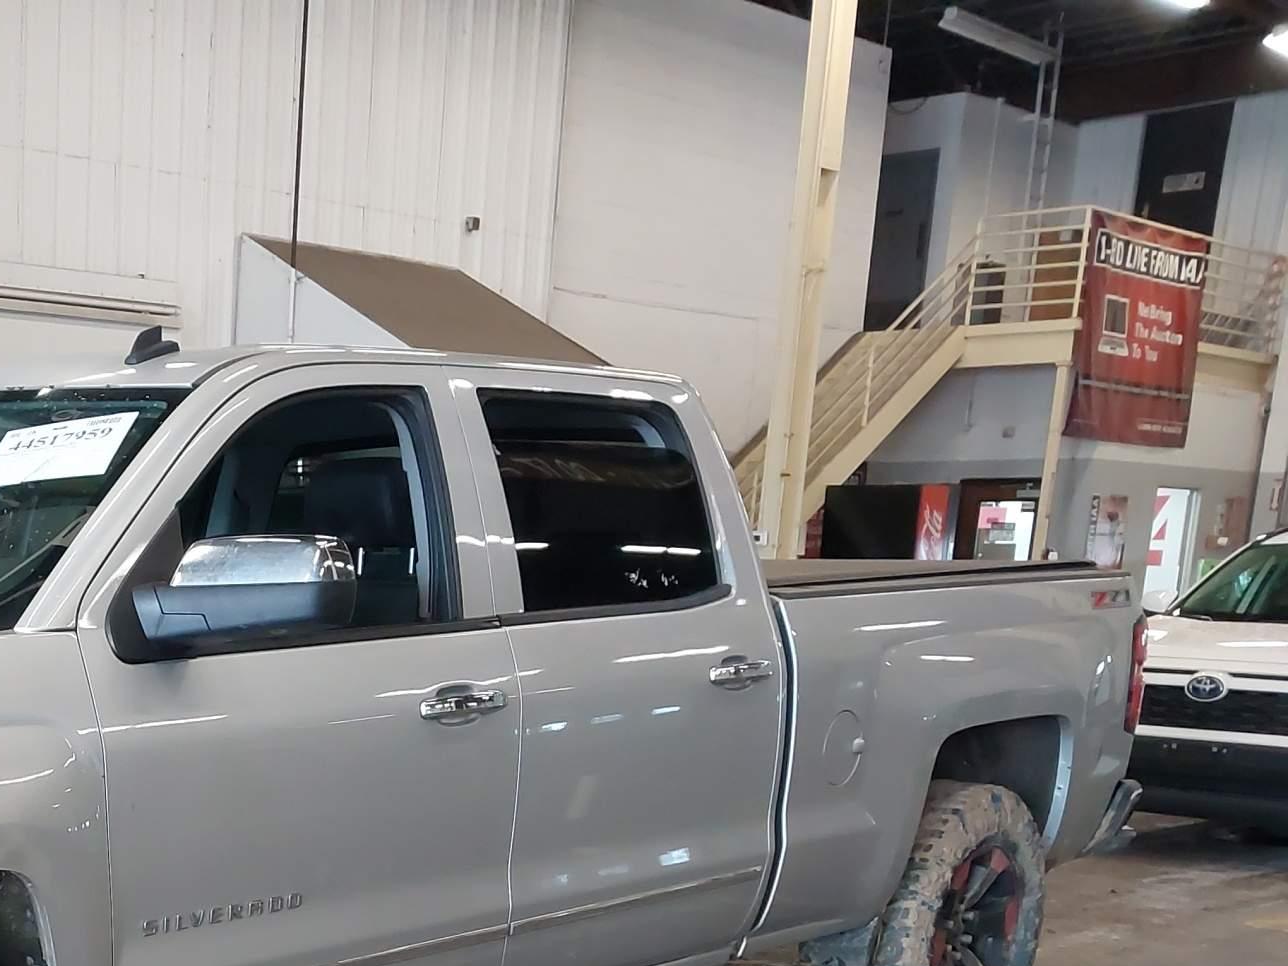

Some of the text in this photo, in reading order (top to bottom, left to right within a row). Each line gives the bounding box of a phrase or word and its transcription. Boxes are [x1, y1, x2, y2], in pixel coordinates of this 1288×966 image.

[1150, 249, 1179, 279] FROM
[1135, 322, 1149, 339] The
[1132, 343, 1159, 362] To You
[9, 427, 113, 451] 44517959
[143, 892, 303, 937] SILVERADO
